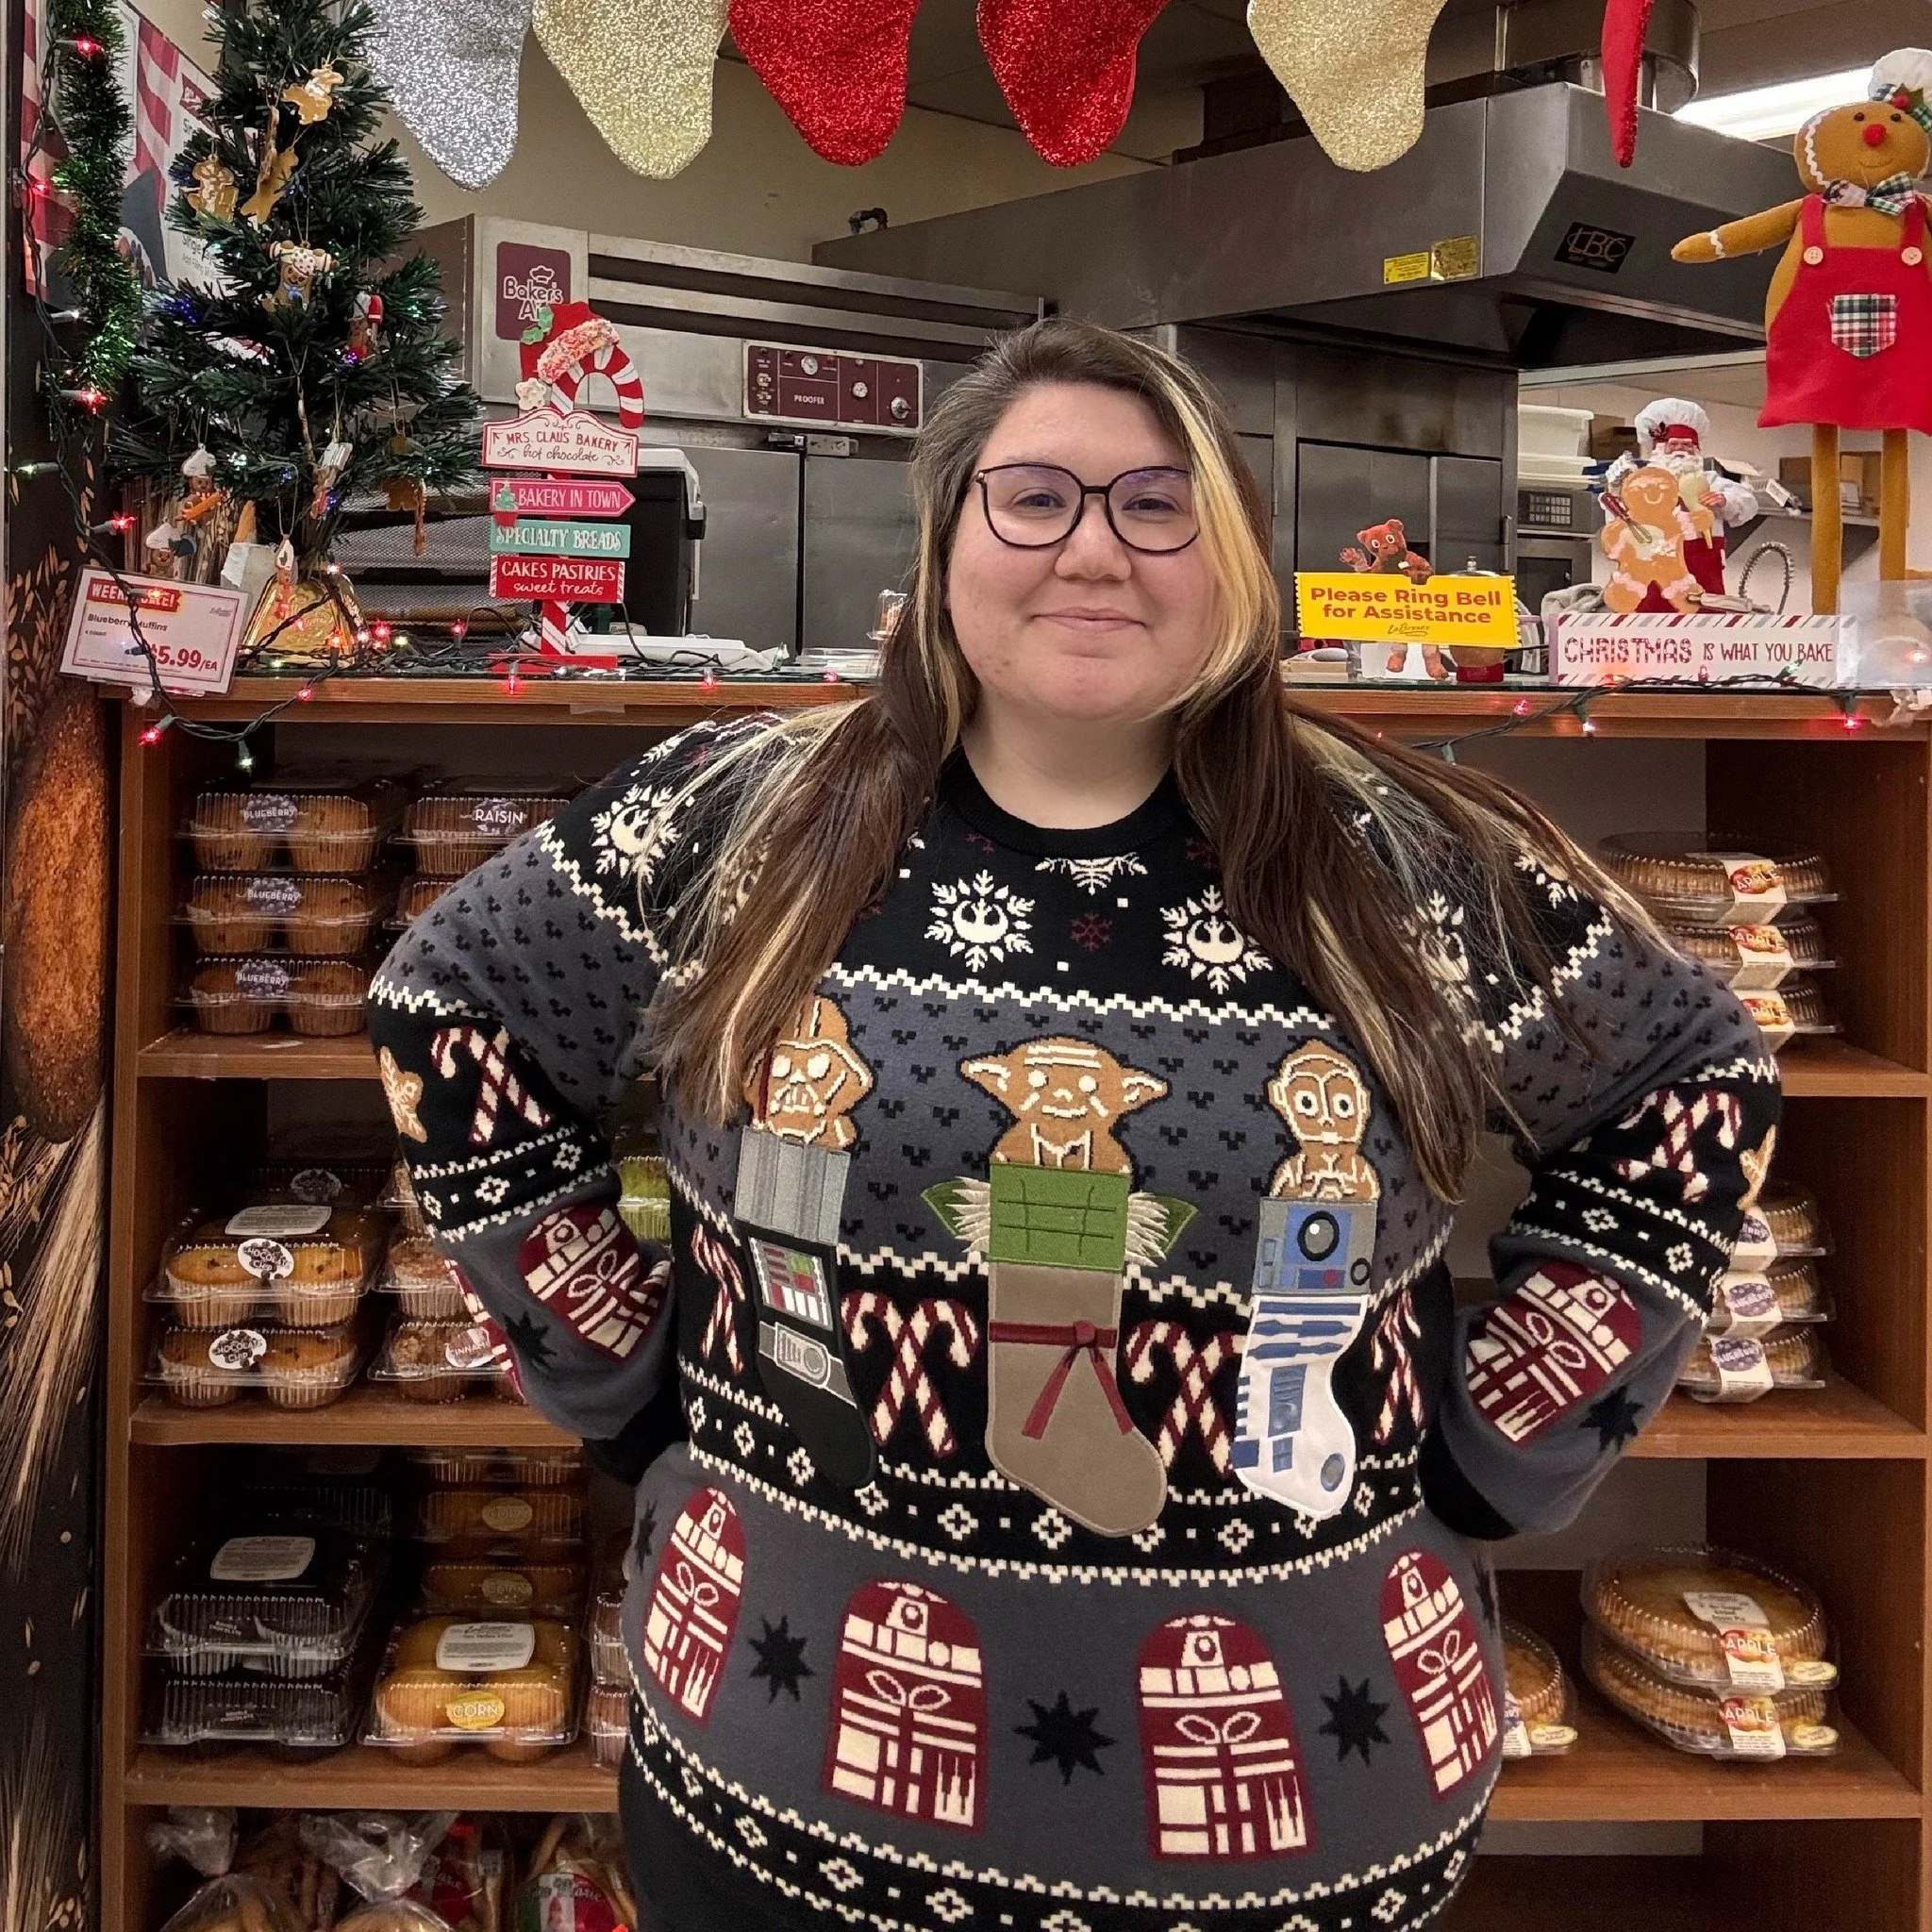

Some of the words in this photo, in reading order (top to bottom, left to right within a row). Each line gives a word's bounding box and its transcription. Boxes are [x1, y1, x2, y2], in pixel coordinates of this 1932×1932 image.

[503, 275, 564, 304] Baker's
[793, 394, 825, 405] PROOFER
[506, 431, 534, 444] MRS.
[537, 431, 570, 444] CLAUS
[576, 434, 619, 452] BAKERY
[523, 444, 542, 460] hot
[546, 446, 599, 462] chocolate
[520, 489, 567, 508] BAKERY
[570, 490, 584, 508] IN
[587, 491, 621, 508] TOWN
[496, 525, 570, 548] SPECIALTY
[573, 530, 622, 550] BREADS
[501, 560, 547, 578] CAKES
[552, 563, 617, 580] PASTRIES
[513, 581, 556, 593] sweet
[560, 582, 604, 595] treats
[1310, 587, 1388, 602] Please
[1394, 589, 1448, 608] Ring
[1456, 591, 1501, 606] Bell
[87, 613, 131, 628] Blueberry
[139, 621, 168, 632] uffins
[1323, 604, 1356, 618] for
[1363, 605, 1491, 624] Assistance
[1564, 637, 1692, 663] CHRISTMAS
[1703, 642, 1715, 661] IS
[1721, 642, 1757, 661] WHAT
[1766, 642, 1792, 662] YOU
[1797, 642, 1833, 662] BAKE
[243, 807, 296, 820] BLUEBERRY
[475, 808, 525, 825] RAISIN
[1736, 869, 1780, 890] APPLE
[247, 889, 301, 903] BLUEBERRY
[1735, 932, 1787, 949] APPLE
[237, 971, 289, 986] BLUEBERRY
[1725, 1637, 1776, 1657] APPLE
[453, 1703, 500, 1717] CORN
[1724, 1708, 1776, 1724] APPLE
